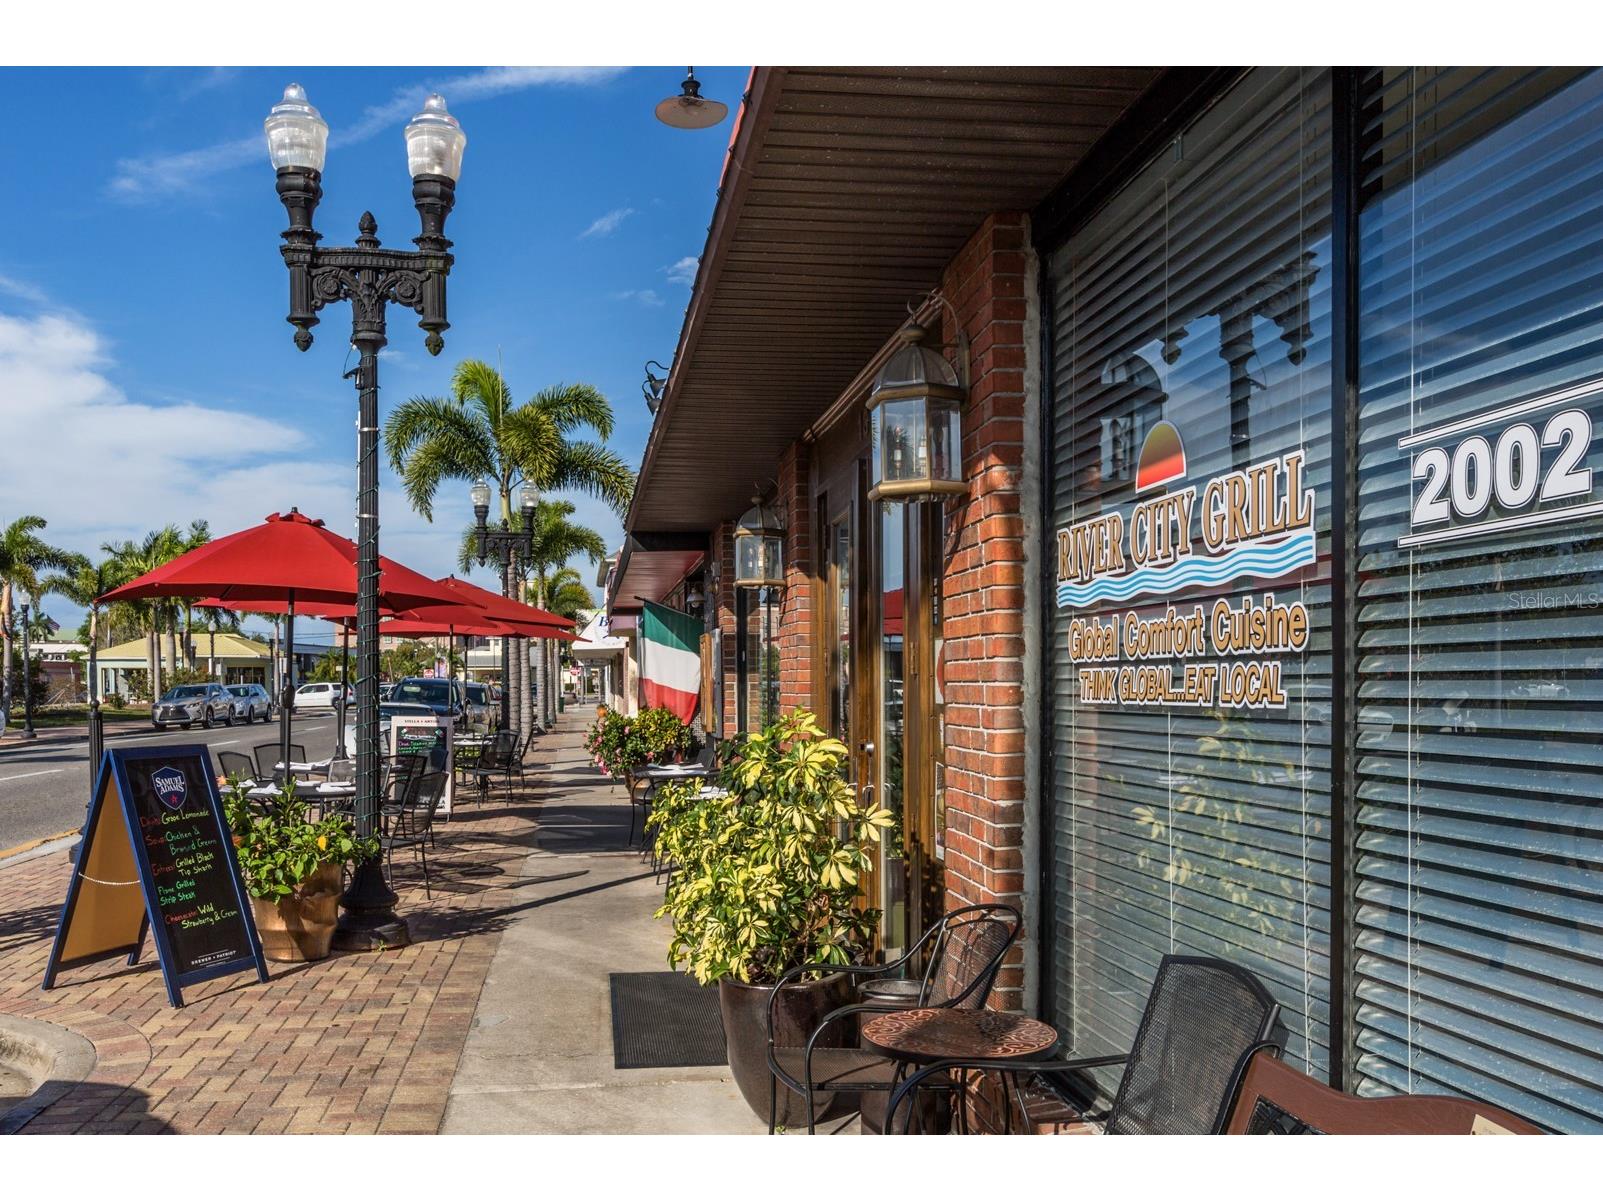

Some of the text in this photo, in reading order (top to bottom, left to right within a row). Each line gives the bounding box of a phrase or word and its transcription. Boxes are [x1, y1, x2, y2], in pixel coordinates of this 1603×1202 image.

[1411, 408, 1593, 528] 2002
[1056, 449, 1317, 585] RIVER CITY GRILL
[1068, 592, 1310, 663] Global Comfort Cuisine
[1079, 667, 1117, 704] THINK
[1219, 660, 1288, 709] LOCAL
[155, 775, 184, 788] SAMUEL
[160, 784, 185, 795] ADAMS
[175, 855, 196, 869] Grilled
[178, 867, 192, 877] Tip
[175, 878, 196, 890] Grilled
[160, 890, 197, 907] Strip Steak
[197, 902, 214, 914] Wild
[181, 916, 215, 929] Strawberry
[213, 910, 222, 922] &
[216, 950, 237, 959] PATRIOT
